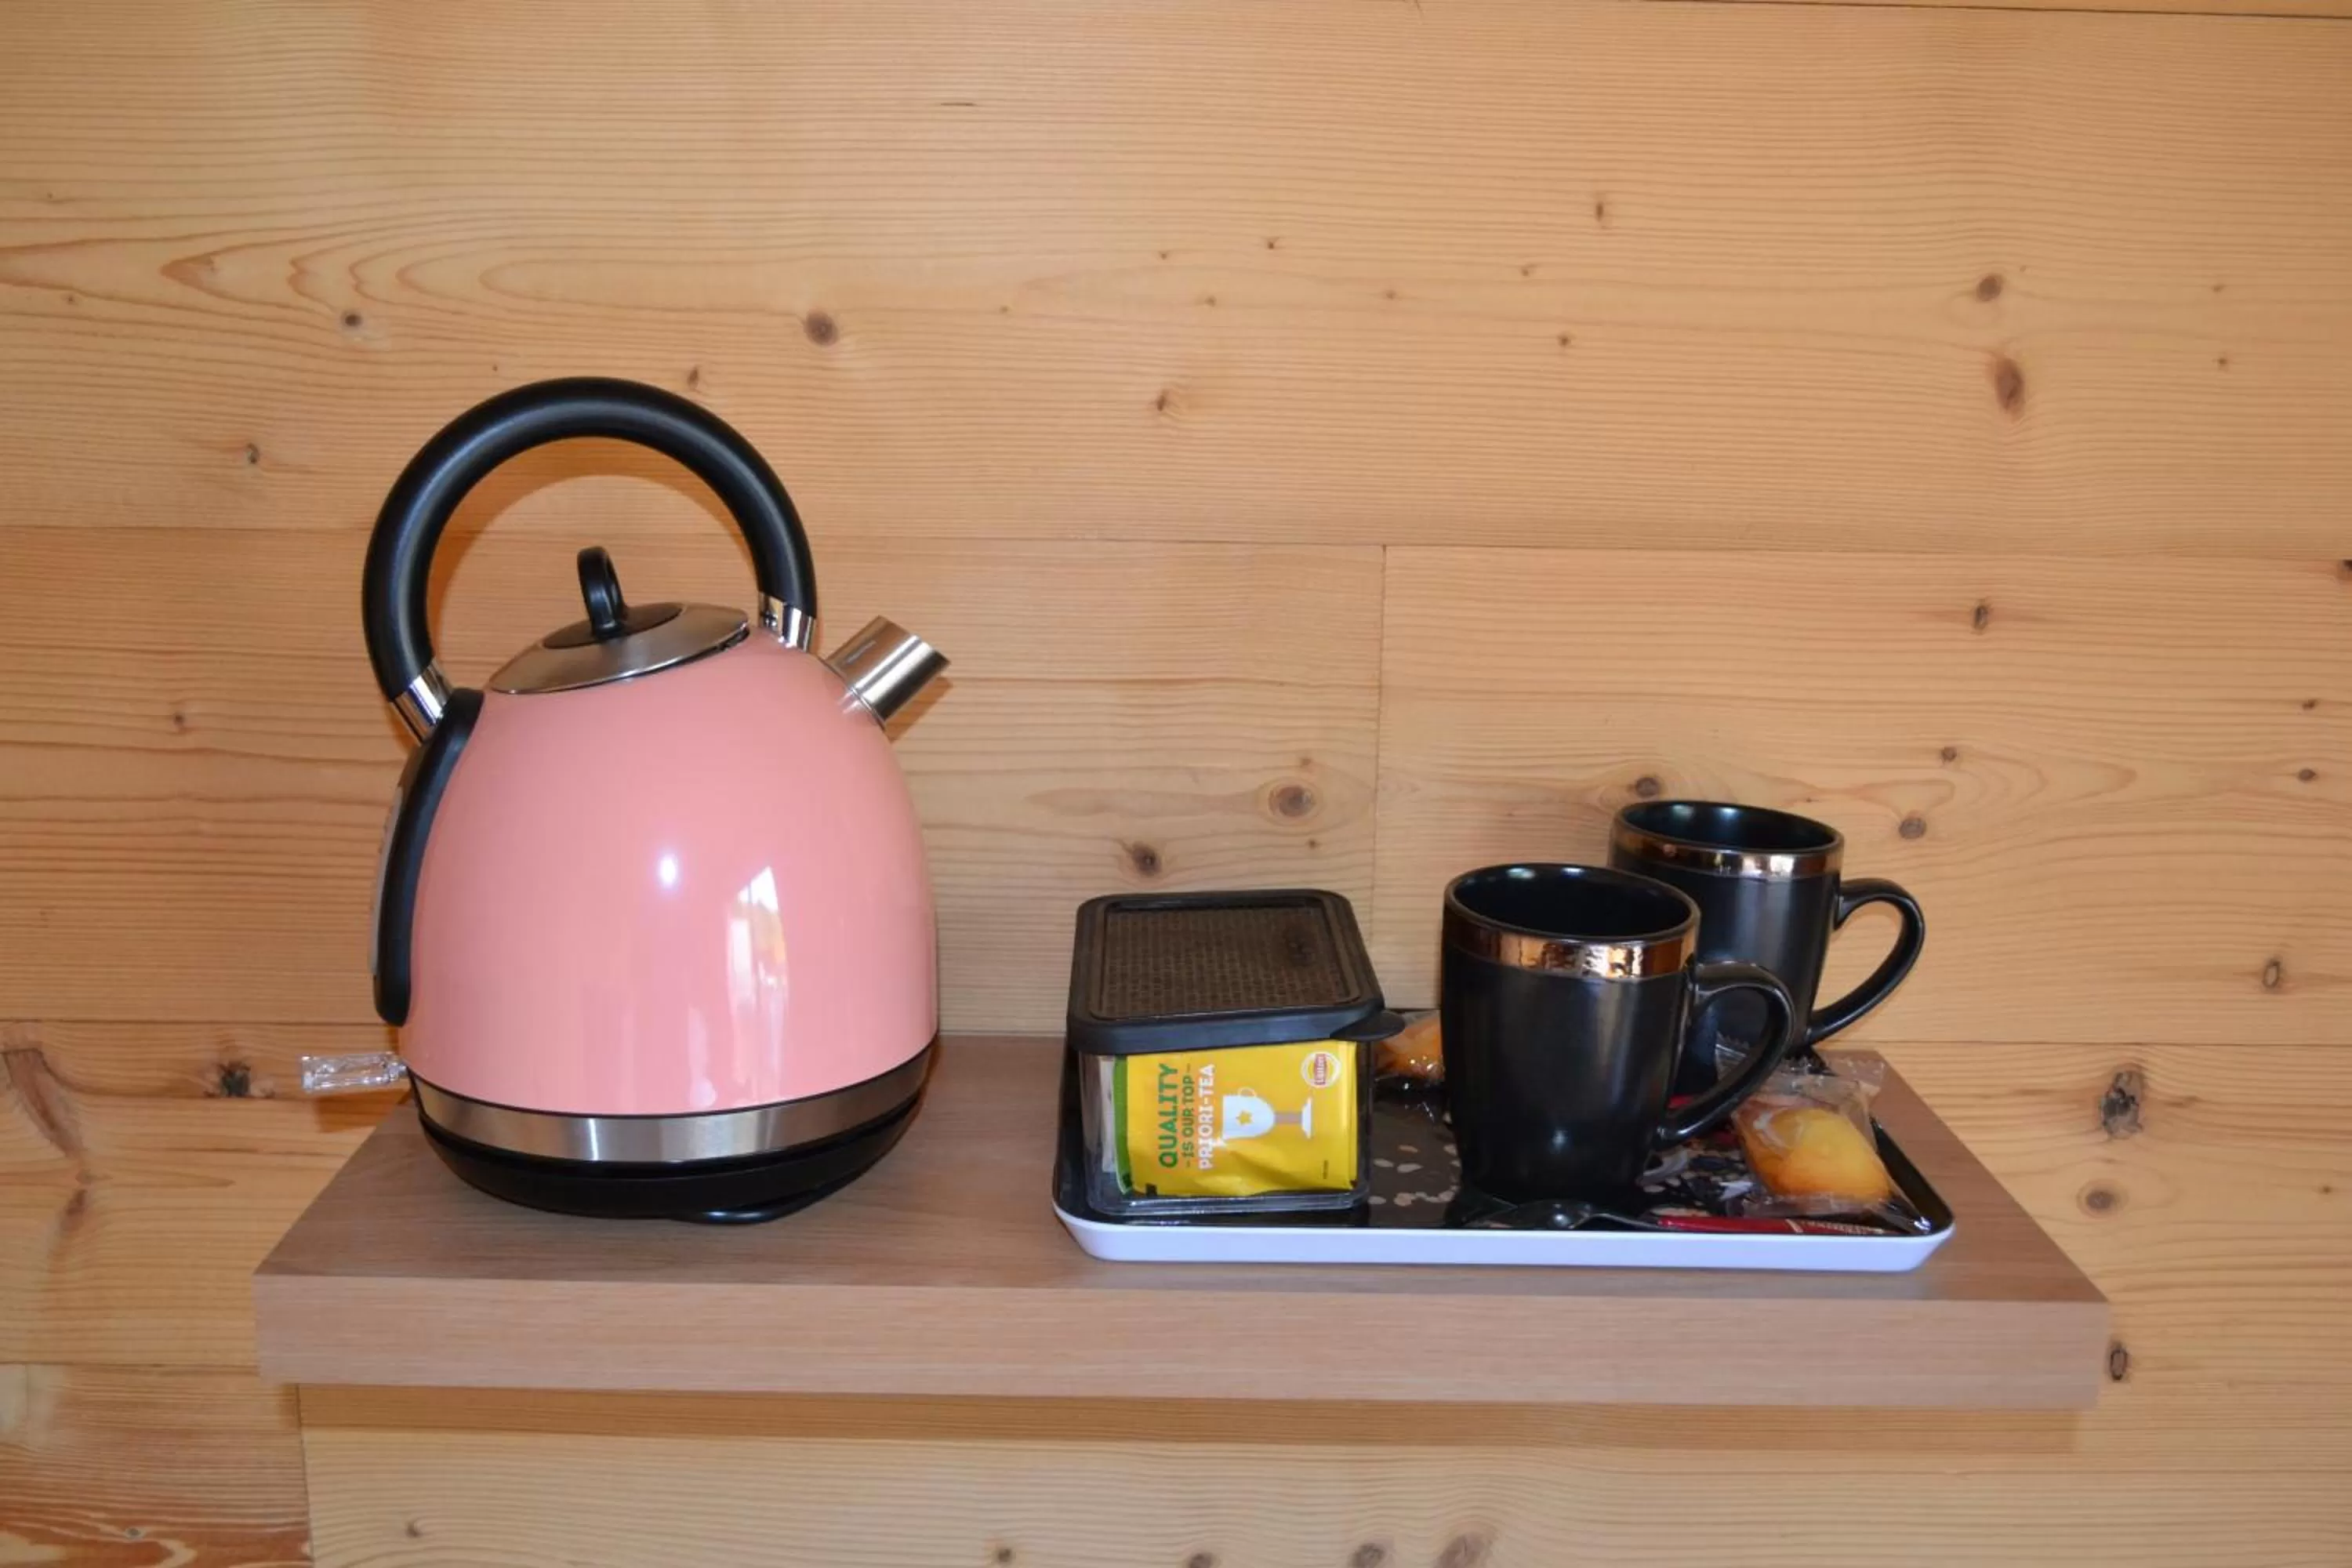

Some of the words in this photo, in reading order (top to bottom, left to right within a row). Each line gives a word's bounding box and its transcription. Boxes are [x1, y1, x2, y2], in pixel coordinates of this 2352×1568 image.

[1159, 1063, 1178, 1167] QUALITY
[1182, 1075, 1194, 1103] TOP
[1198, 1064, 1216, 1170] PRIORI-TEA
[1182, 1108, 1194, 1137] OUR
